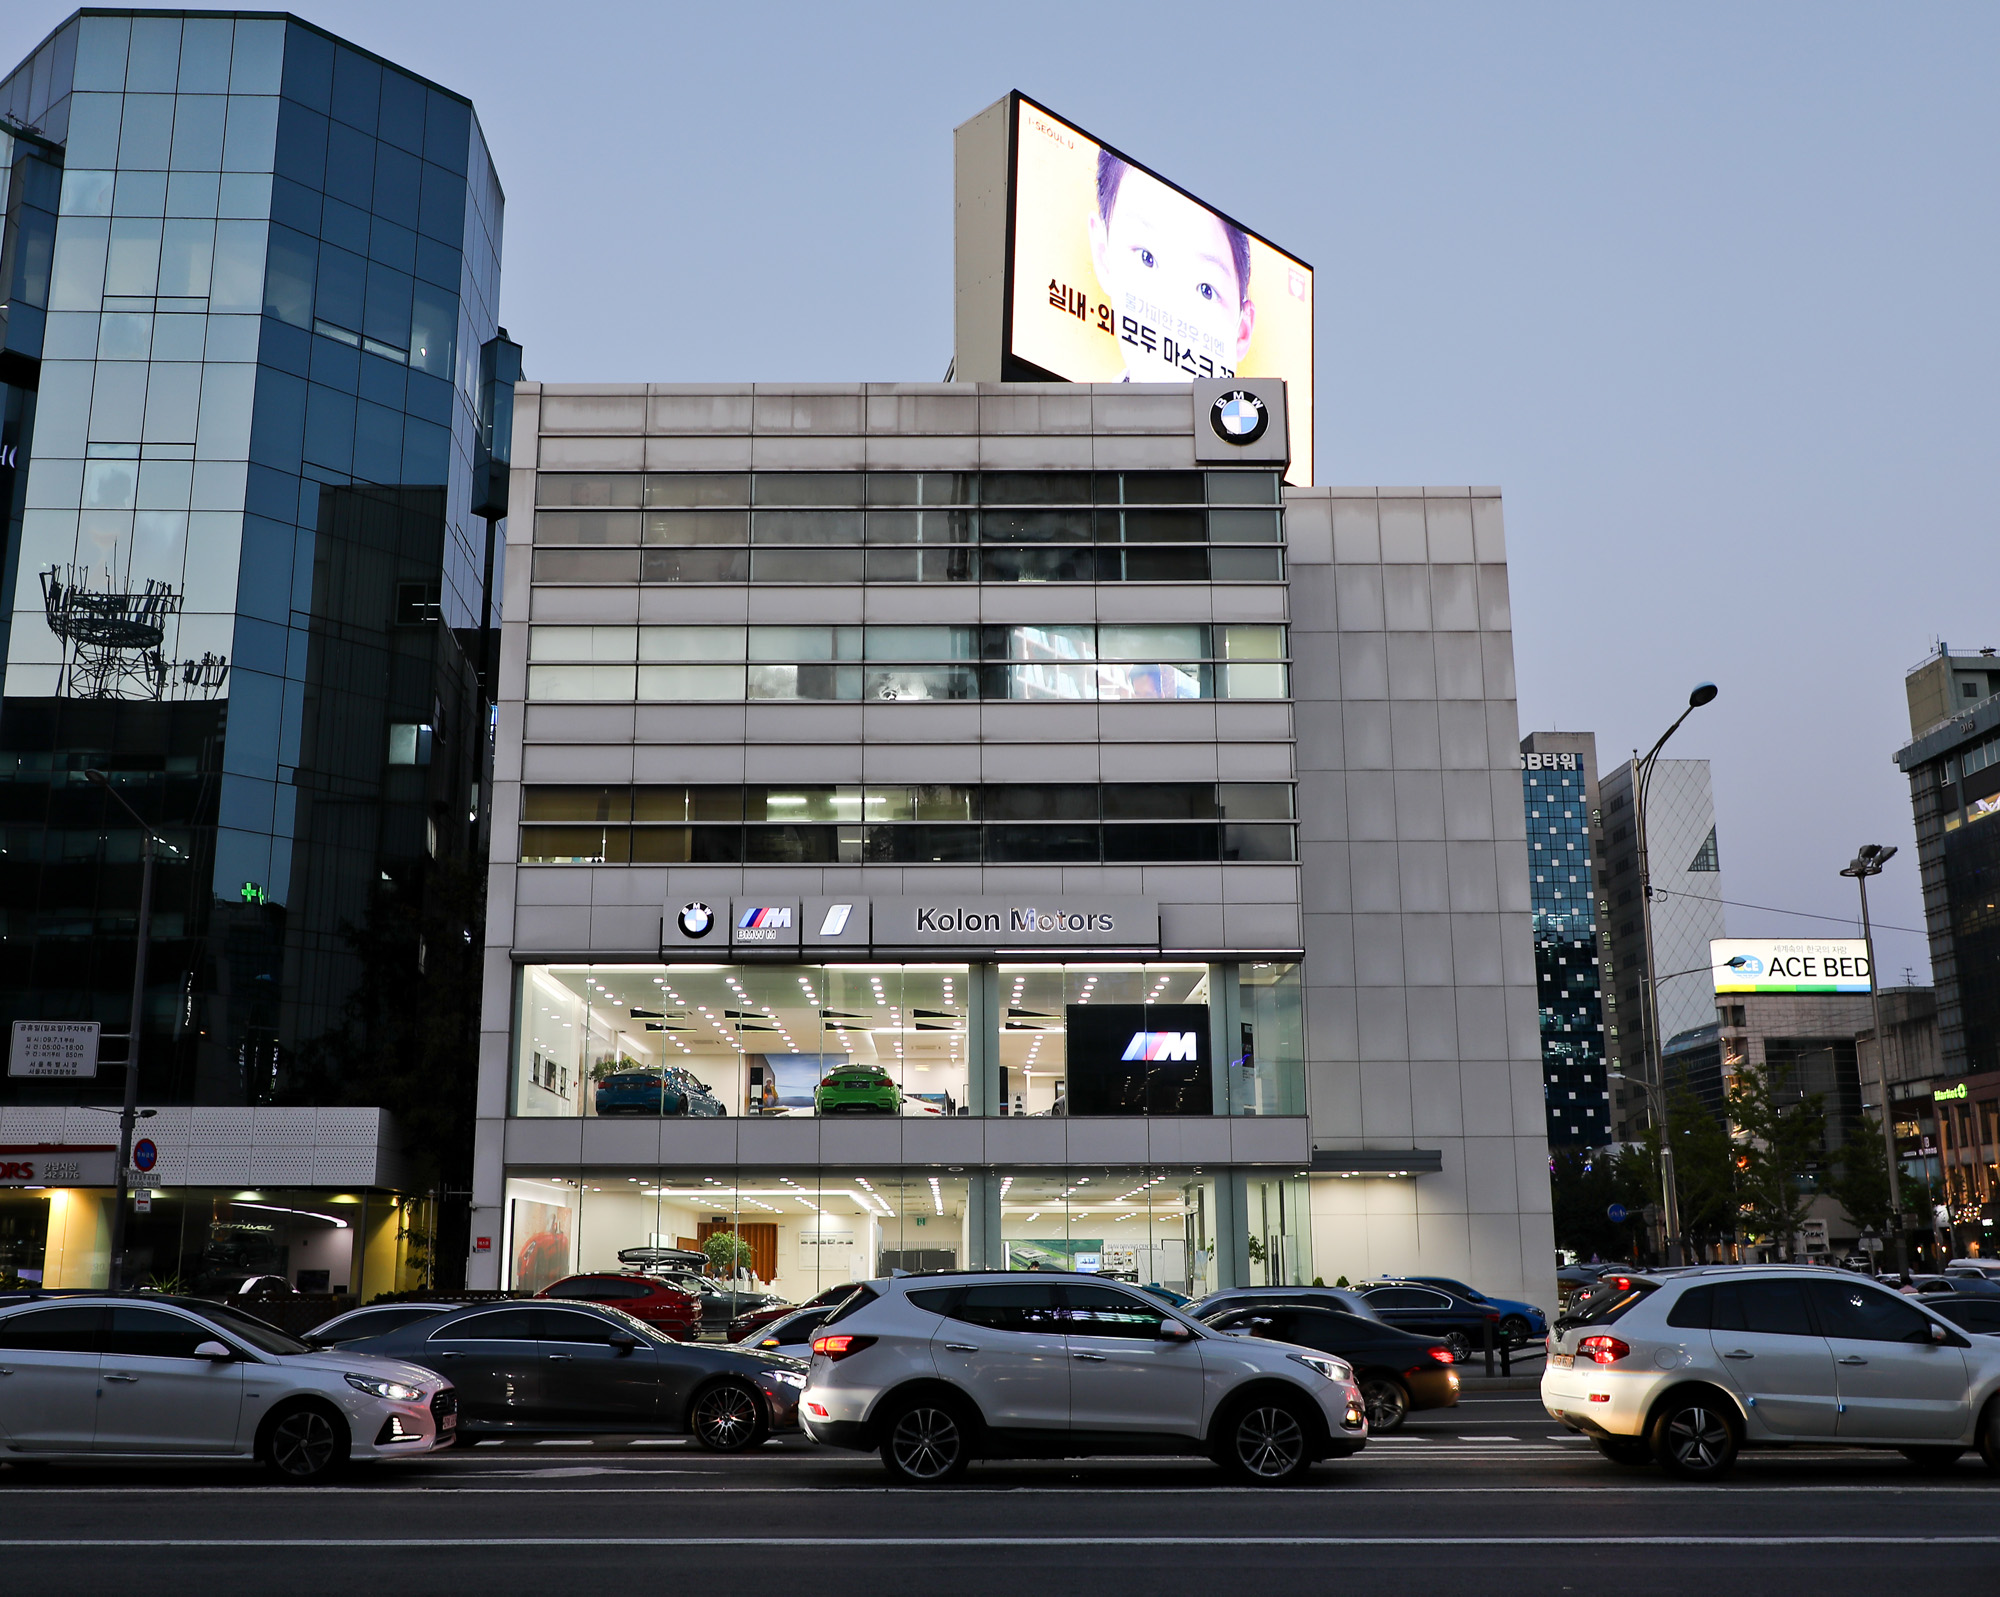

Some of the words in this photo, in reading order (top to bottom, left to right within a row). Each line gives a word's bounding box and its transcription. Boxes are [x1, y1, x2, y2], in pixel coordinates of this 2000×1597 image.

[1121, 315, 1157, 353] 모두
[1163, 336, 1213, 378] 마스크
[917, 907, 1001, 932] Kolon
[1010, 907, 1114, 932] Motors
[737, 929, 765, 940] BMW
[765, 929, 777, 940] M
[1773, 945, 1804, 953] 세계속의
[1806, 945, 1830, 954] 한국의
[1832, 946, 1847, 954] 자랑
[1768, 957, 1817, 977] ACE
[1823, 957, 1870, 977] BED
